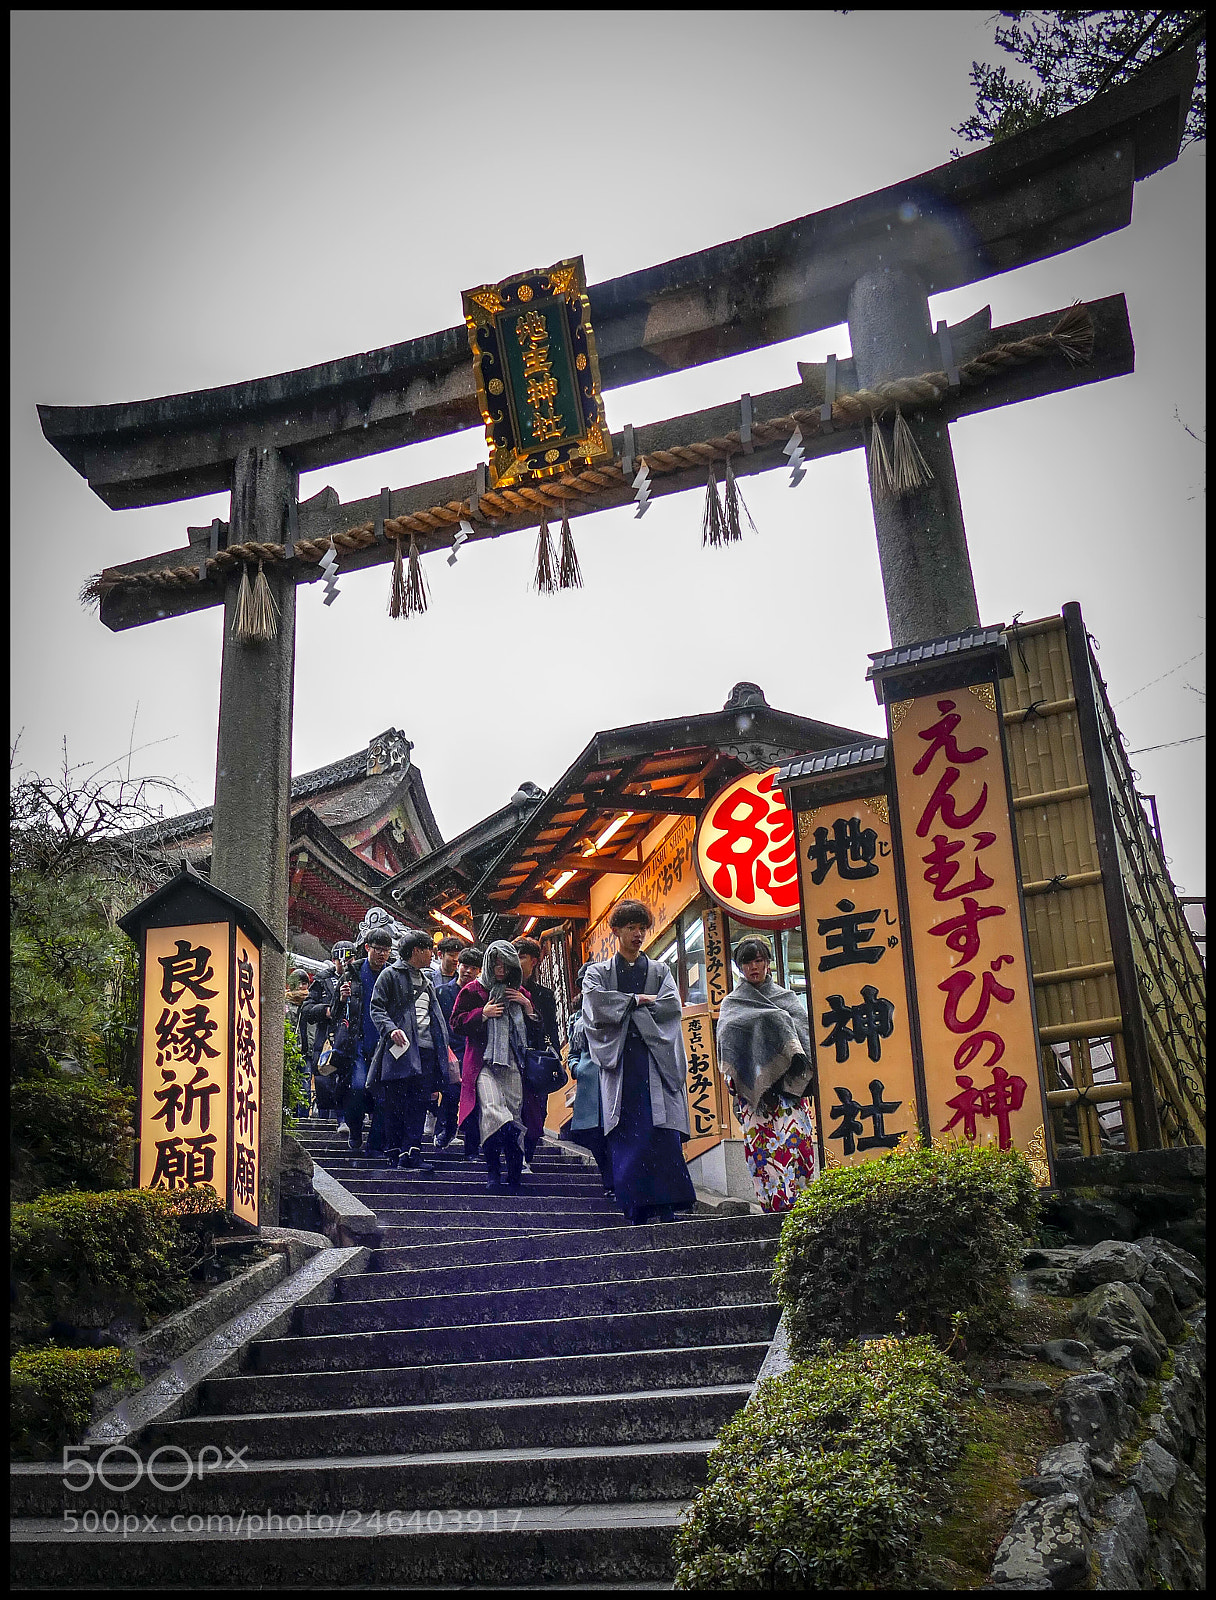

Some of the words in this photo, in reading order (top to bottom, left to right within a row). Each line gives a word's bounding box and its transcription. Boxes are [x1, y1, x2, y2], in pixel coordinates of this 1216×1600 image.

[808, 817, 907, 1156] 地主神社
[912, 699, 1029, 1153] えんむすびの神
[150, 939, 221, 1191] 良縁祈願
[235, 948, 257, 1212] 良縁祈願
[687, 1019, 716, 1134] 恋占いおみくじ
